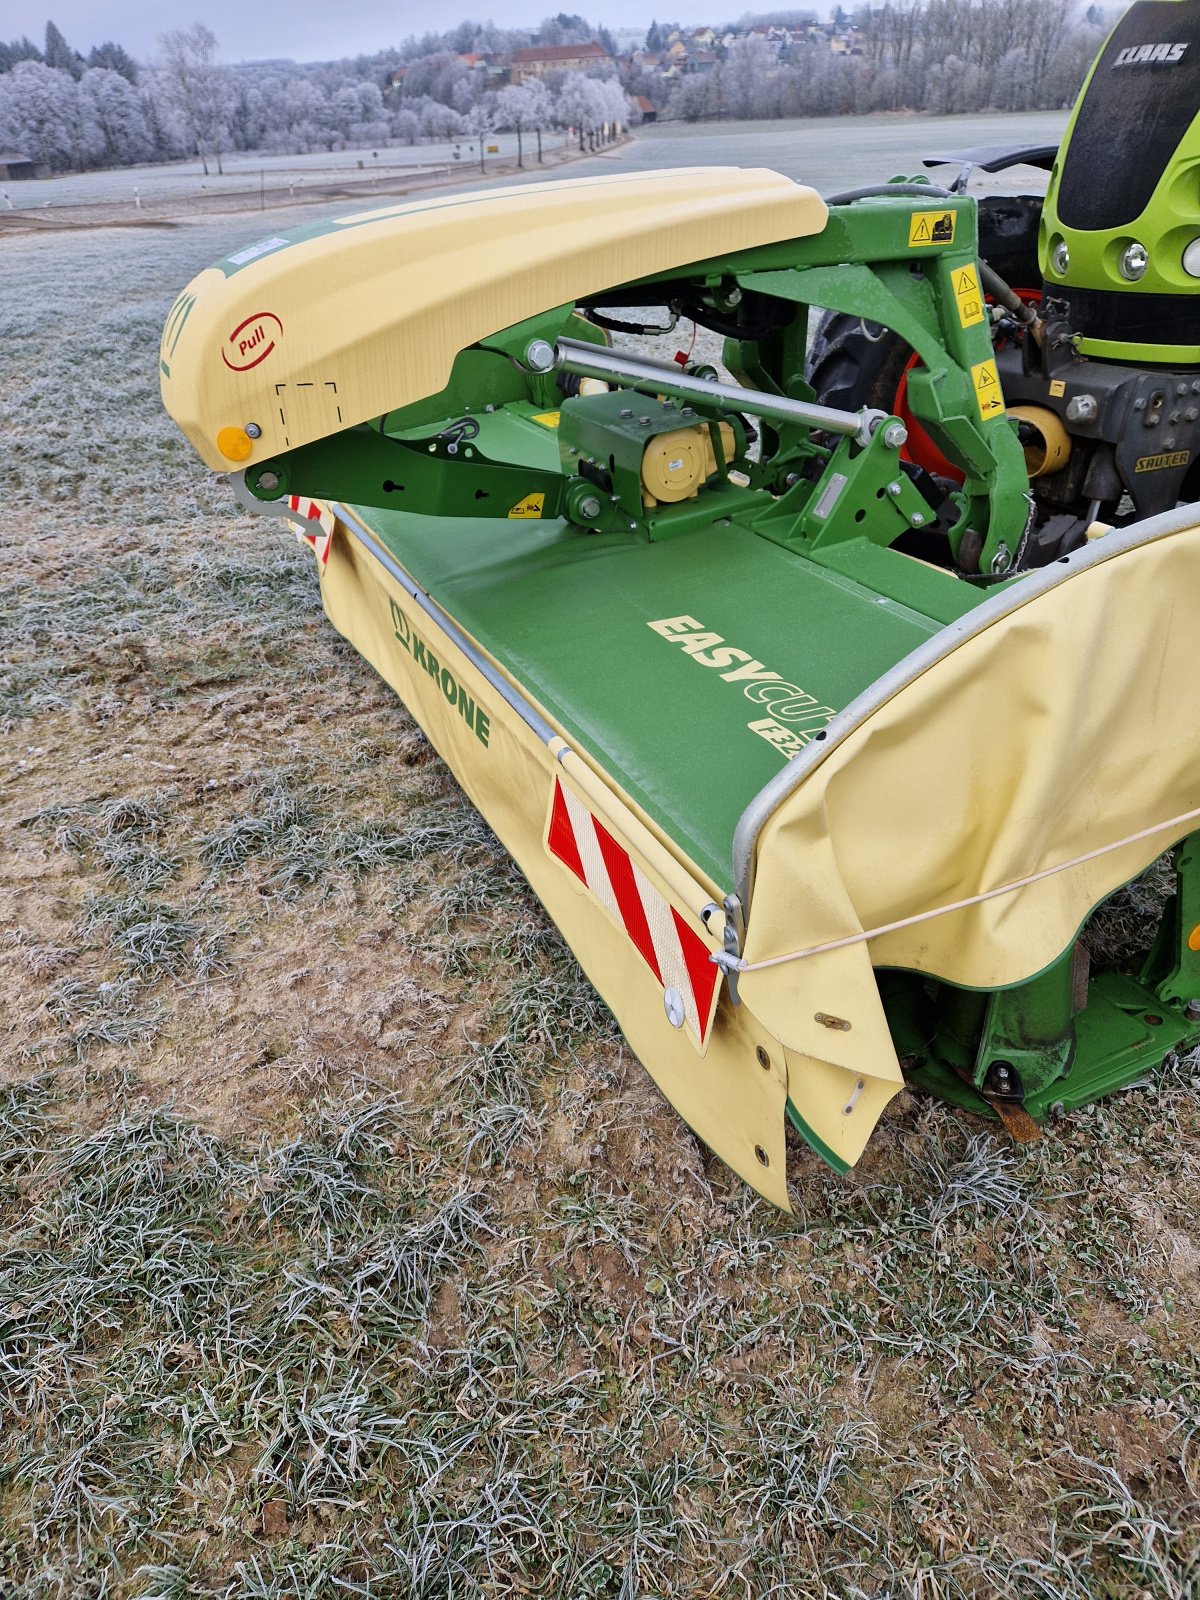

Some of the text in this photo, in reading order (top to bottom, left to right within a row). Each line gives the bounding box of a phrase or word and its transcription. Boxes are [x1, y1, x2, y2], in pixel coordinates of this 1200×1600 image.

[1112, 43, 1190, 66] CLAAS
[239, 325, 265, 356] Pull
[1136, 451, 1189, 471] SAUTER
[412, 631, 490, 749] KRONE
